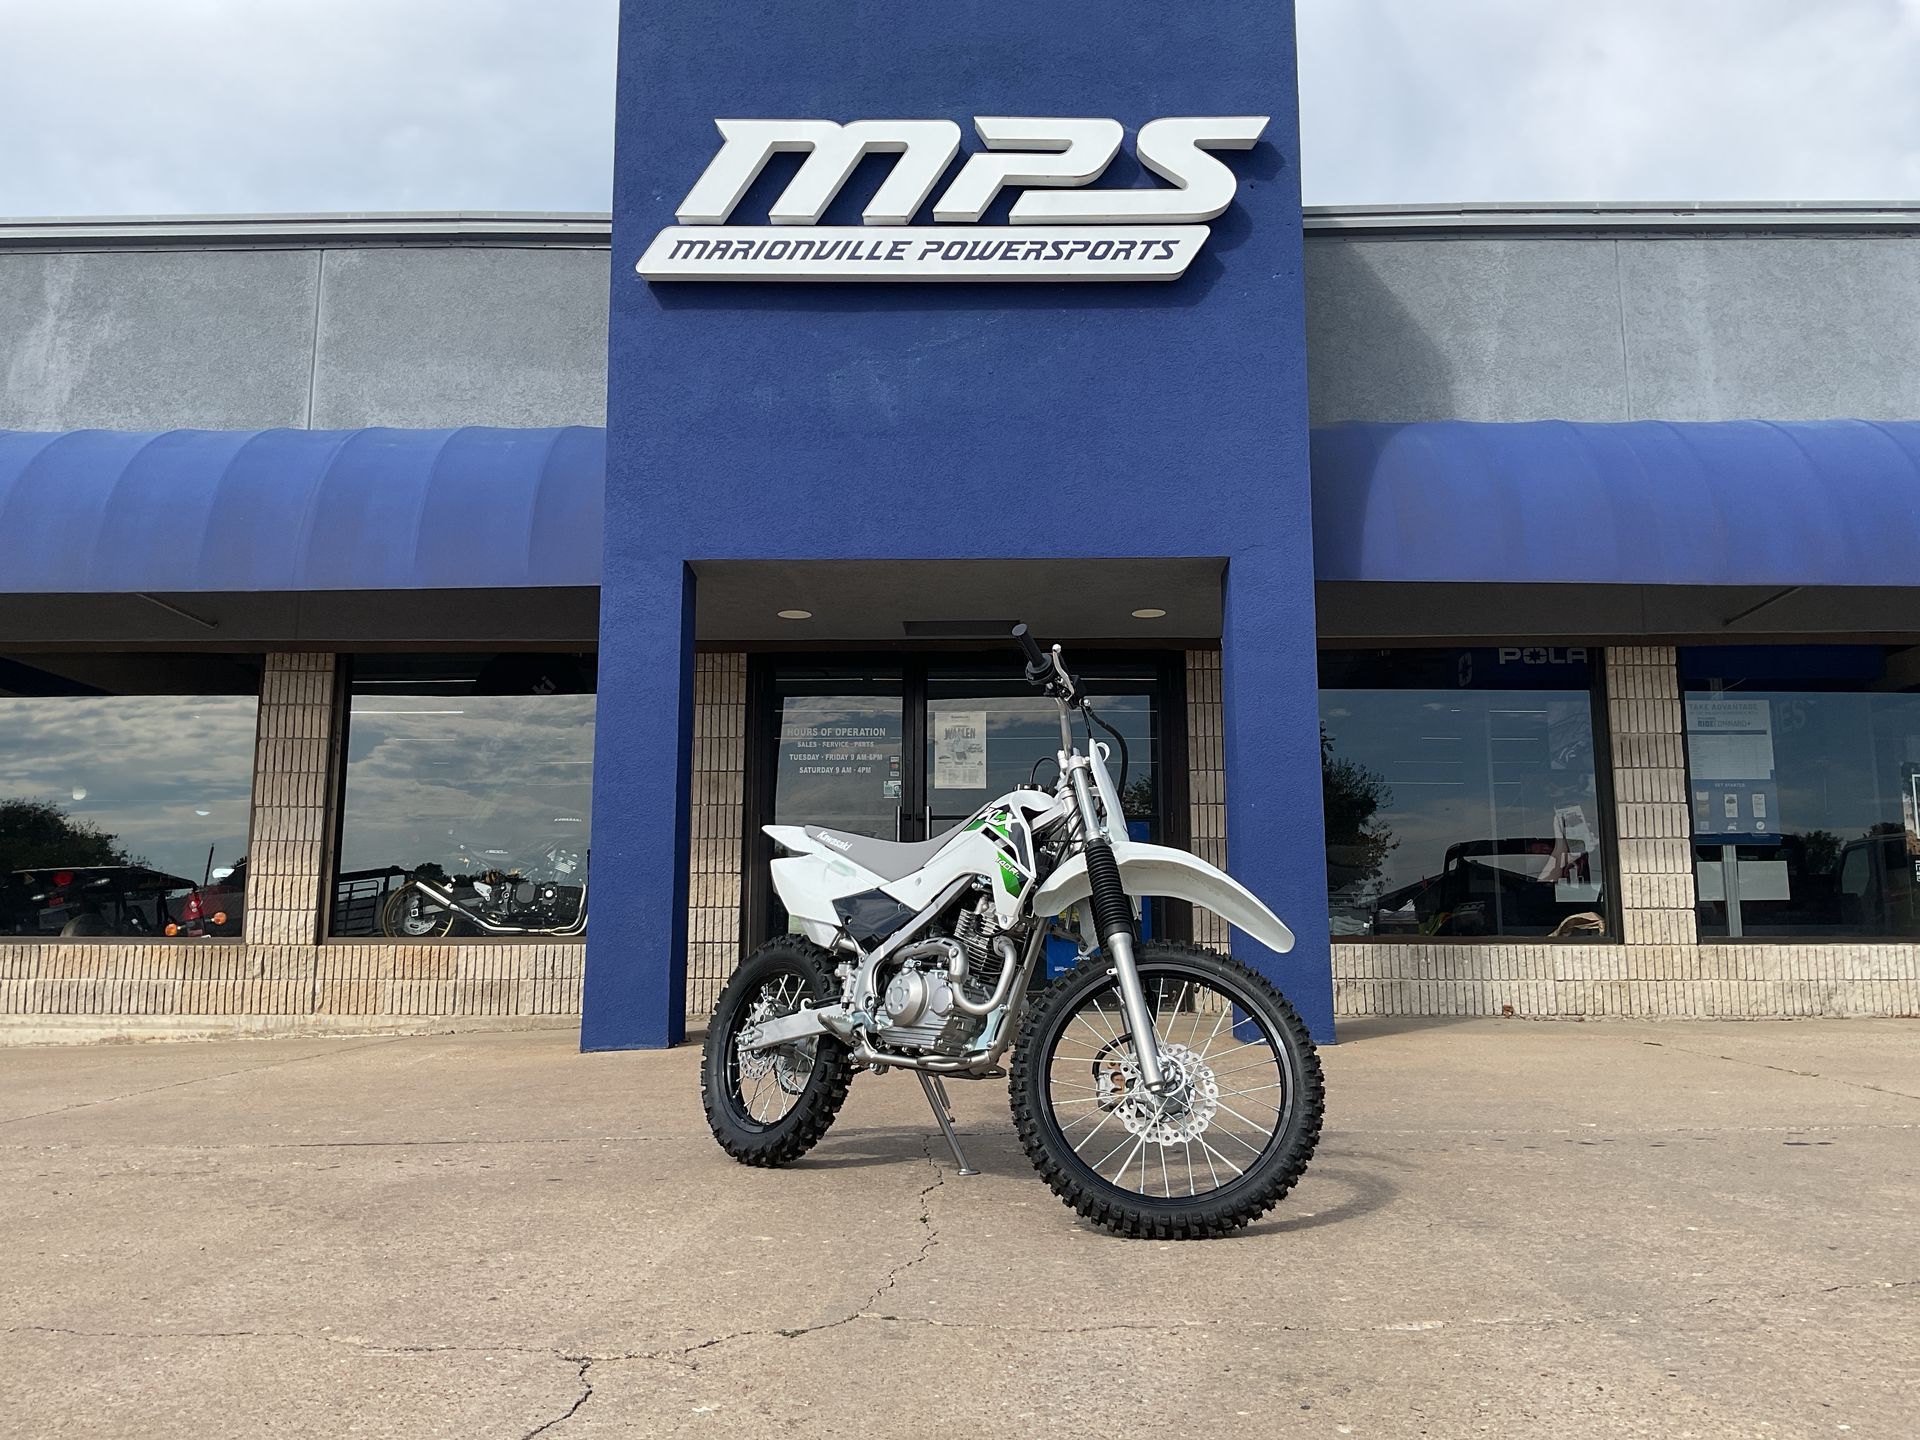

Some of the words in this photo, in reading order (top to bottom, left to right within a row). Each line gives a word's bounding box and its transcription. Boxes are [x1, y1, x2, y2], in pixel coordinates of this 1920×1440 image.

[675, 116, 1271, 225] MPS
[668, 240, 912, 261] MARIONVILLE
[917, 240, 1181, 261] POWERSPORTS
[787, 728, 818, 737] HOURS
[821, 728, 833, 737] OF
[835, 728, 886, 737] OPERATION
[799, 766, 833, 774] SATURDAY
[977, 806, 1020, 832] KLX
[816, 830, 853, 851] Kawasaki
